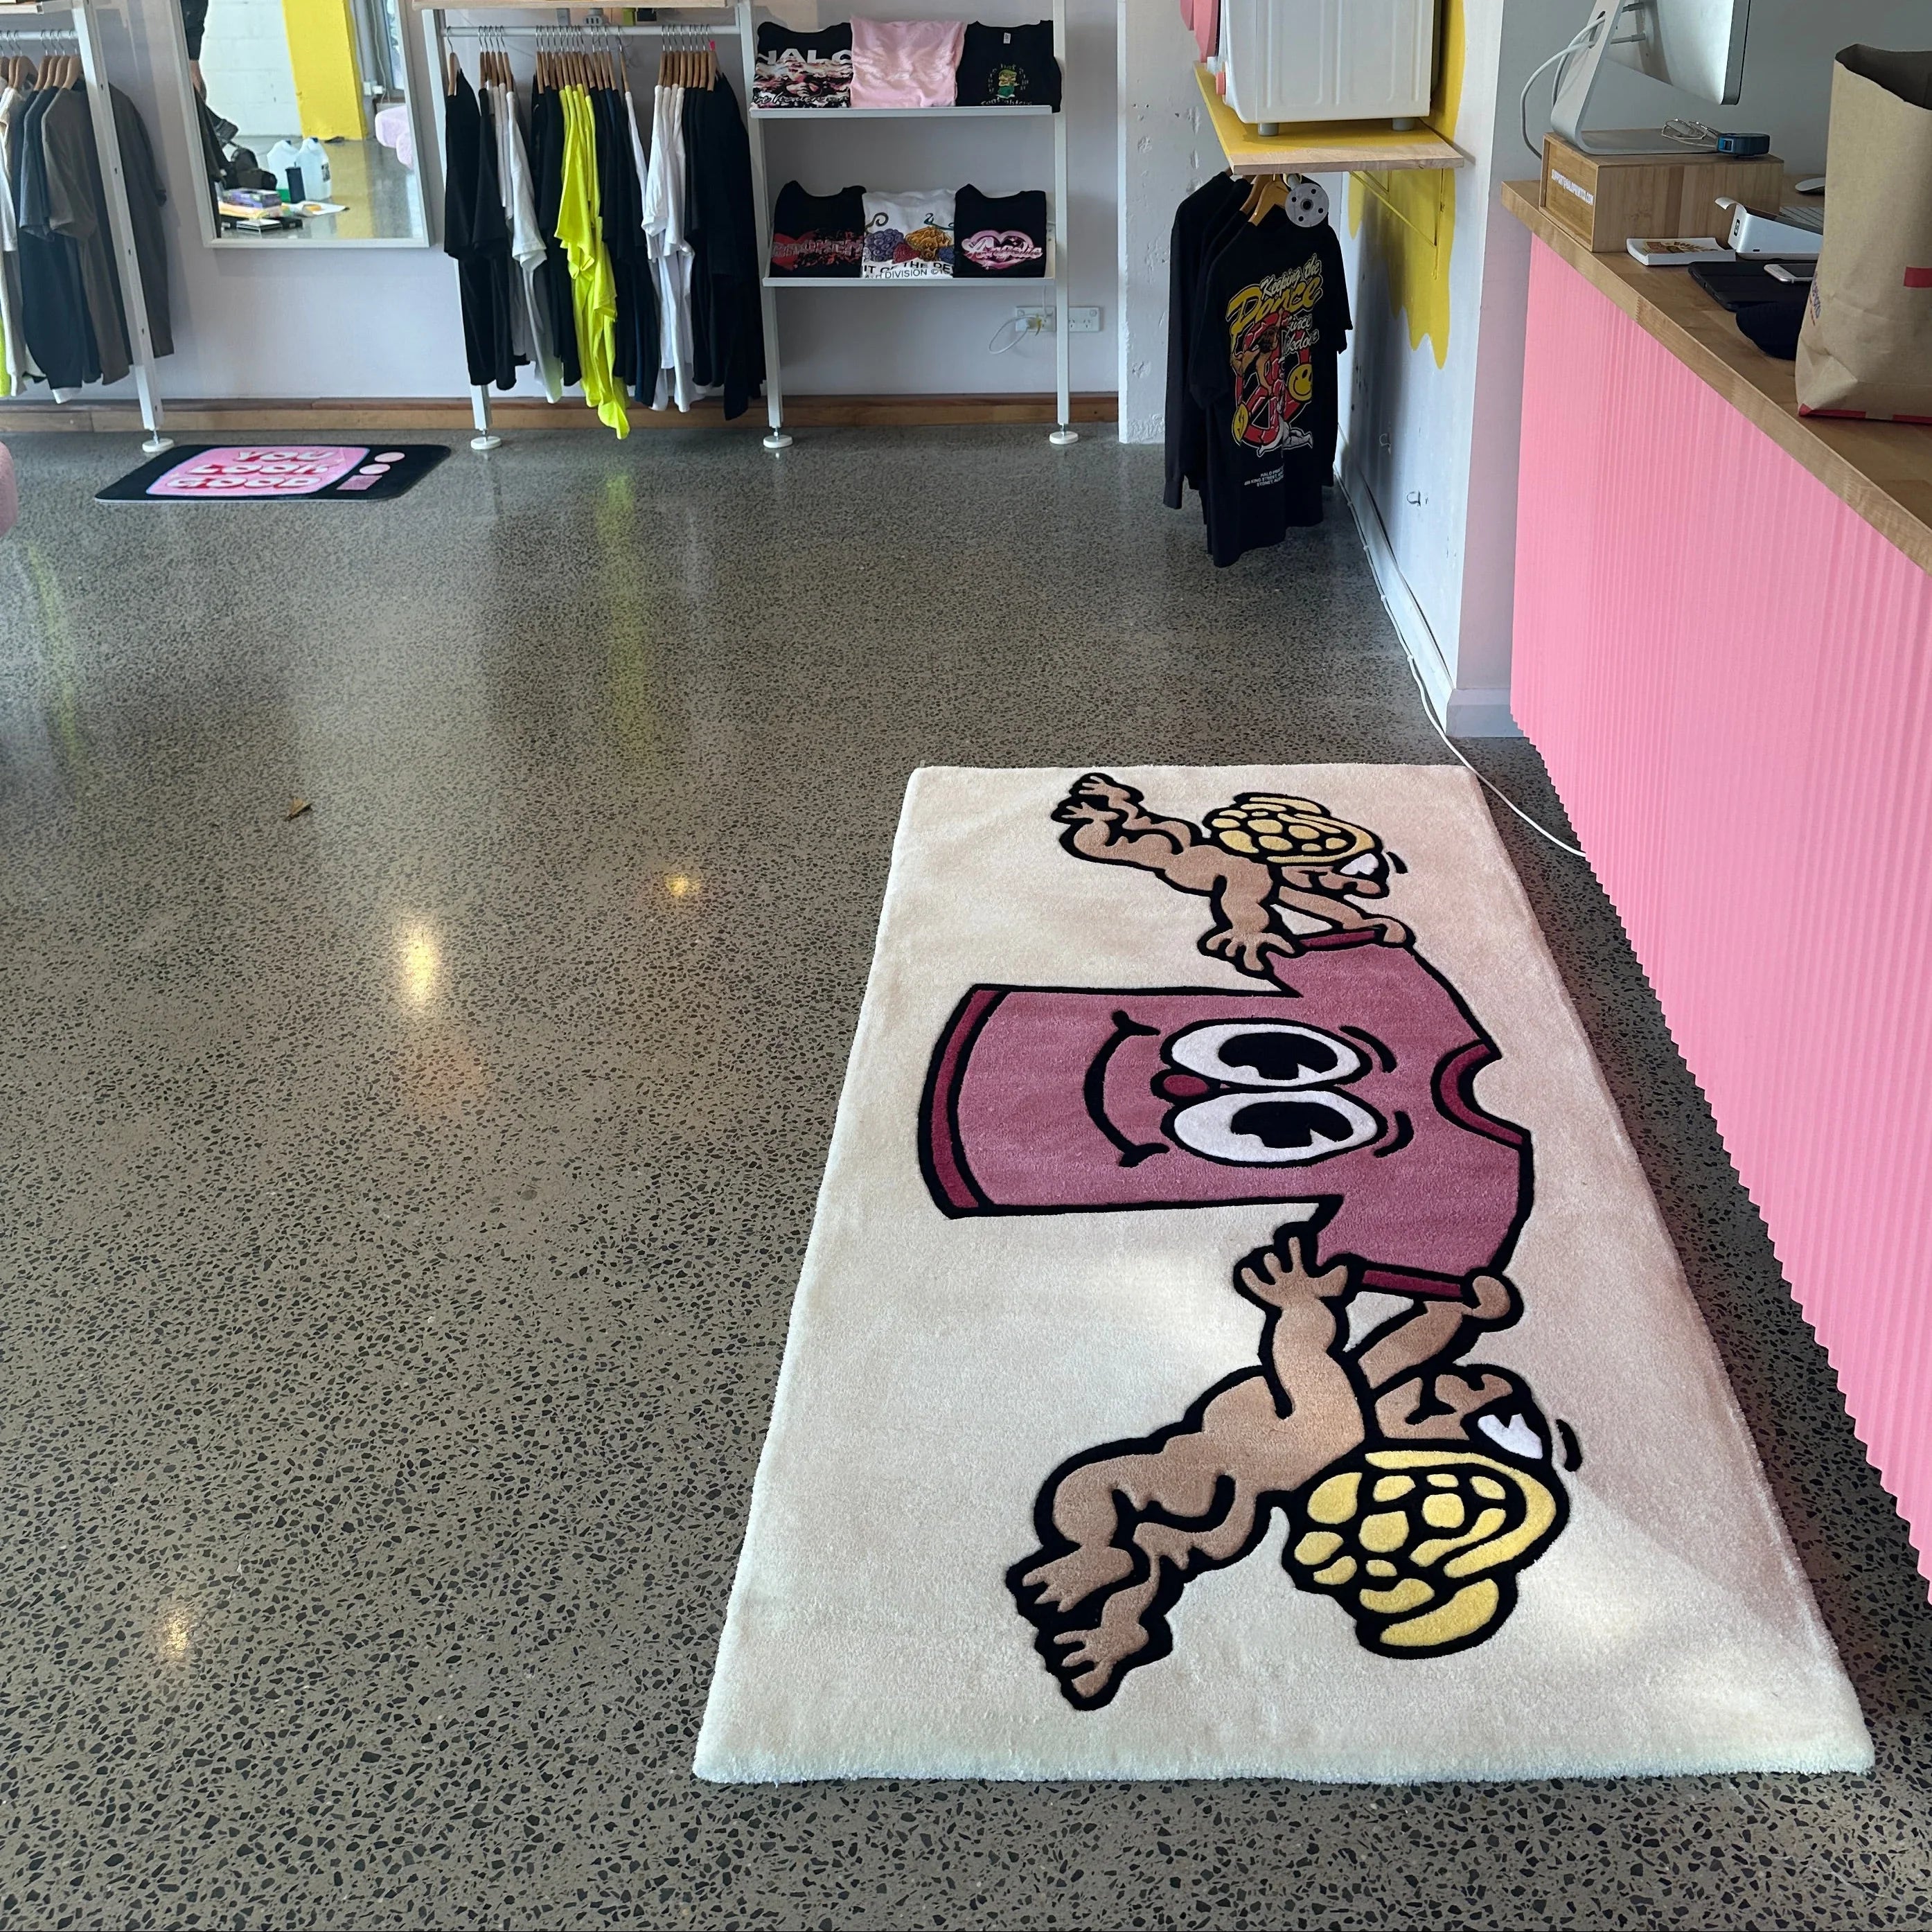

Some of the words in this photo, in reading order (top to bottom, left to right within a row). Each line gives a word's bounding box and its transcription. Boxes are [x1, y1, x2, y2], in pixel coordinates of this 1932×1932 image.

[885, 269, 928, 278] DIVISION
[933, 262, 954, 276] DE
[234, 450, 335, 461] YOU
[188, 463, 330, 474] LOOK
[167, 477, 322, 488] GOOD
